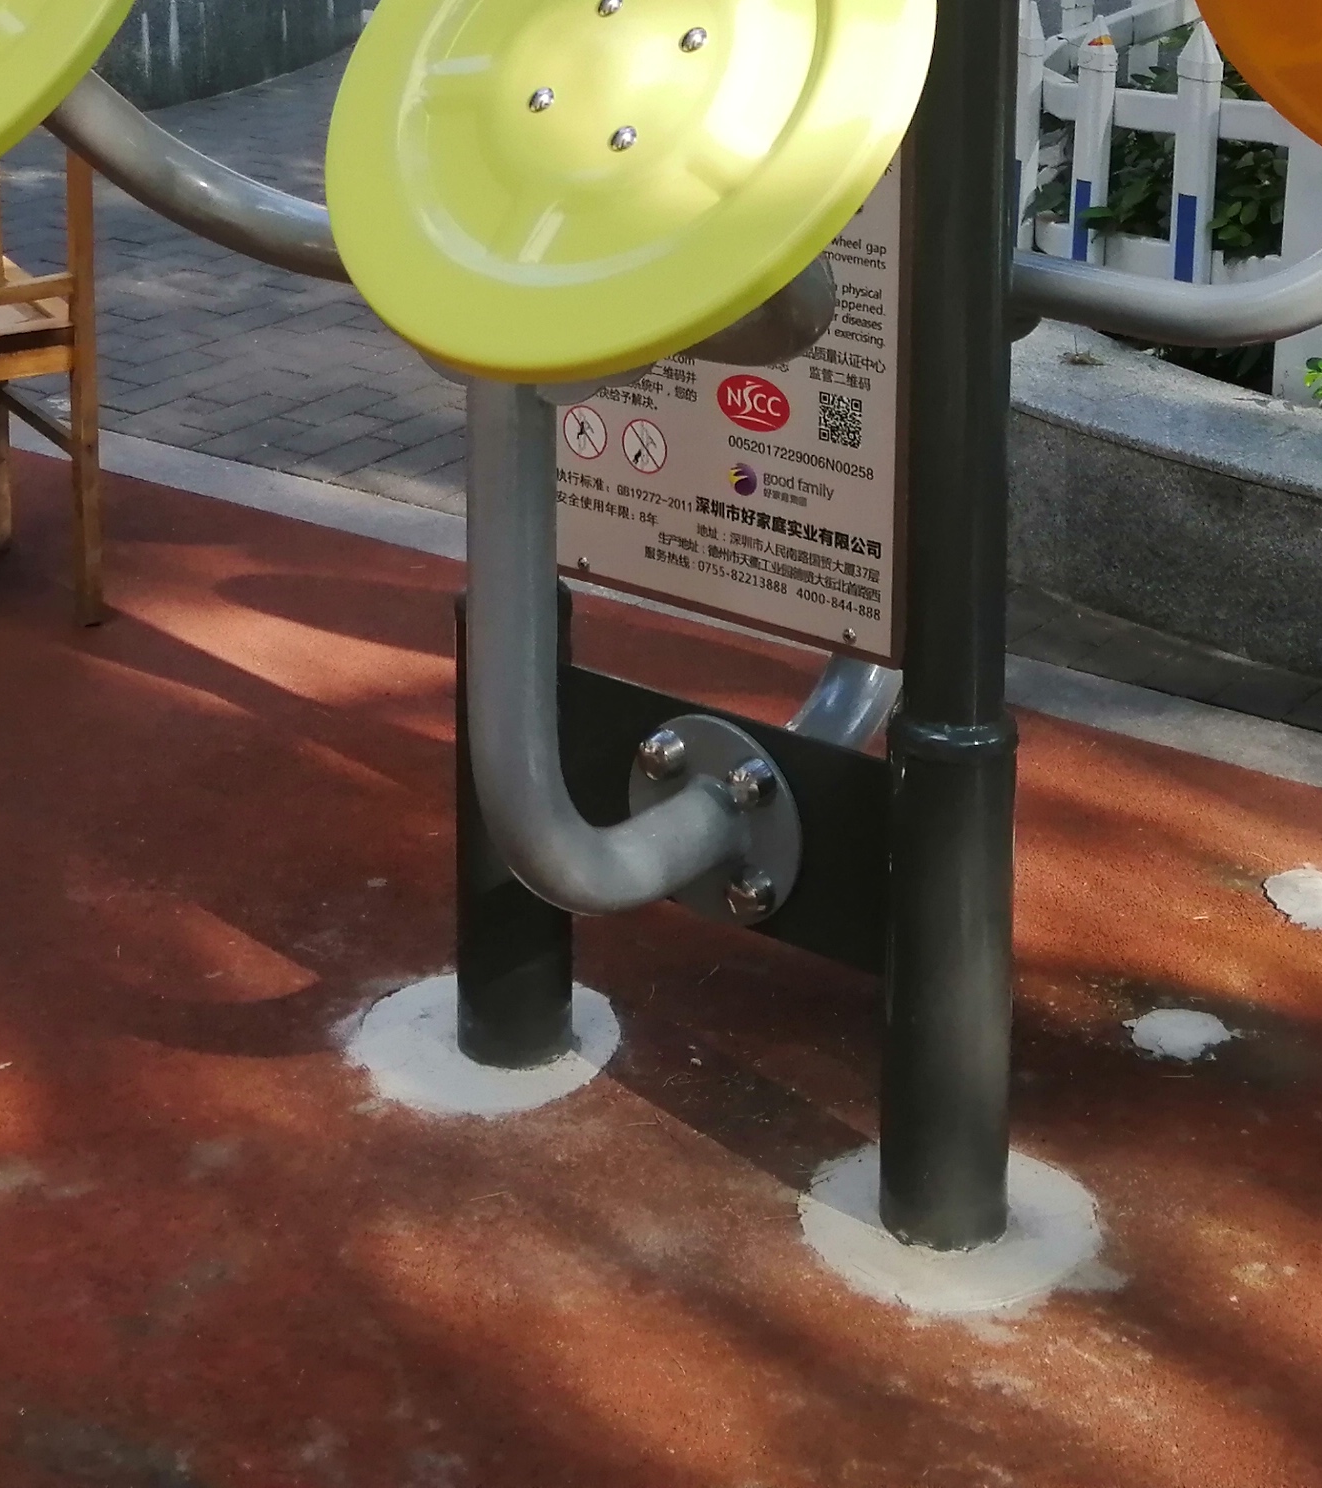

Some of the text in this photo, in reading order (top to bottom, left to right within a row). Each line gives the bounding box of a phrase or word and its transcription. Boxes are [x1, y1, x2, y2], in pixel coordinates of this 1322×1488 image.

[831, 236, 887, 256] wheel gap
[825, 251, 887, 270] movements
[841, 283, 882, 300] physical
[835, 298, 886, 316] appened.
[842, 313, 883, 331] diseases
[809, 366, 871, 392] 监管二维码
[727, 381, 782, 417] NSCC
[728, 435, 875, 481] 0052017229006N00258
[763, 473, 835, 501] good family
[695, 495, 883, 560] 深圳市好家庭实业有限公司
[796, 587, 881, 621] 4000-844-888
